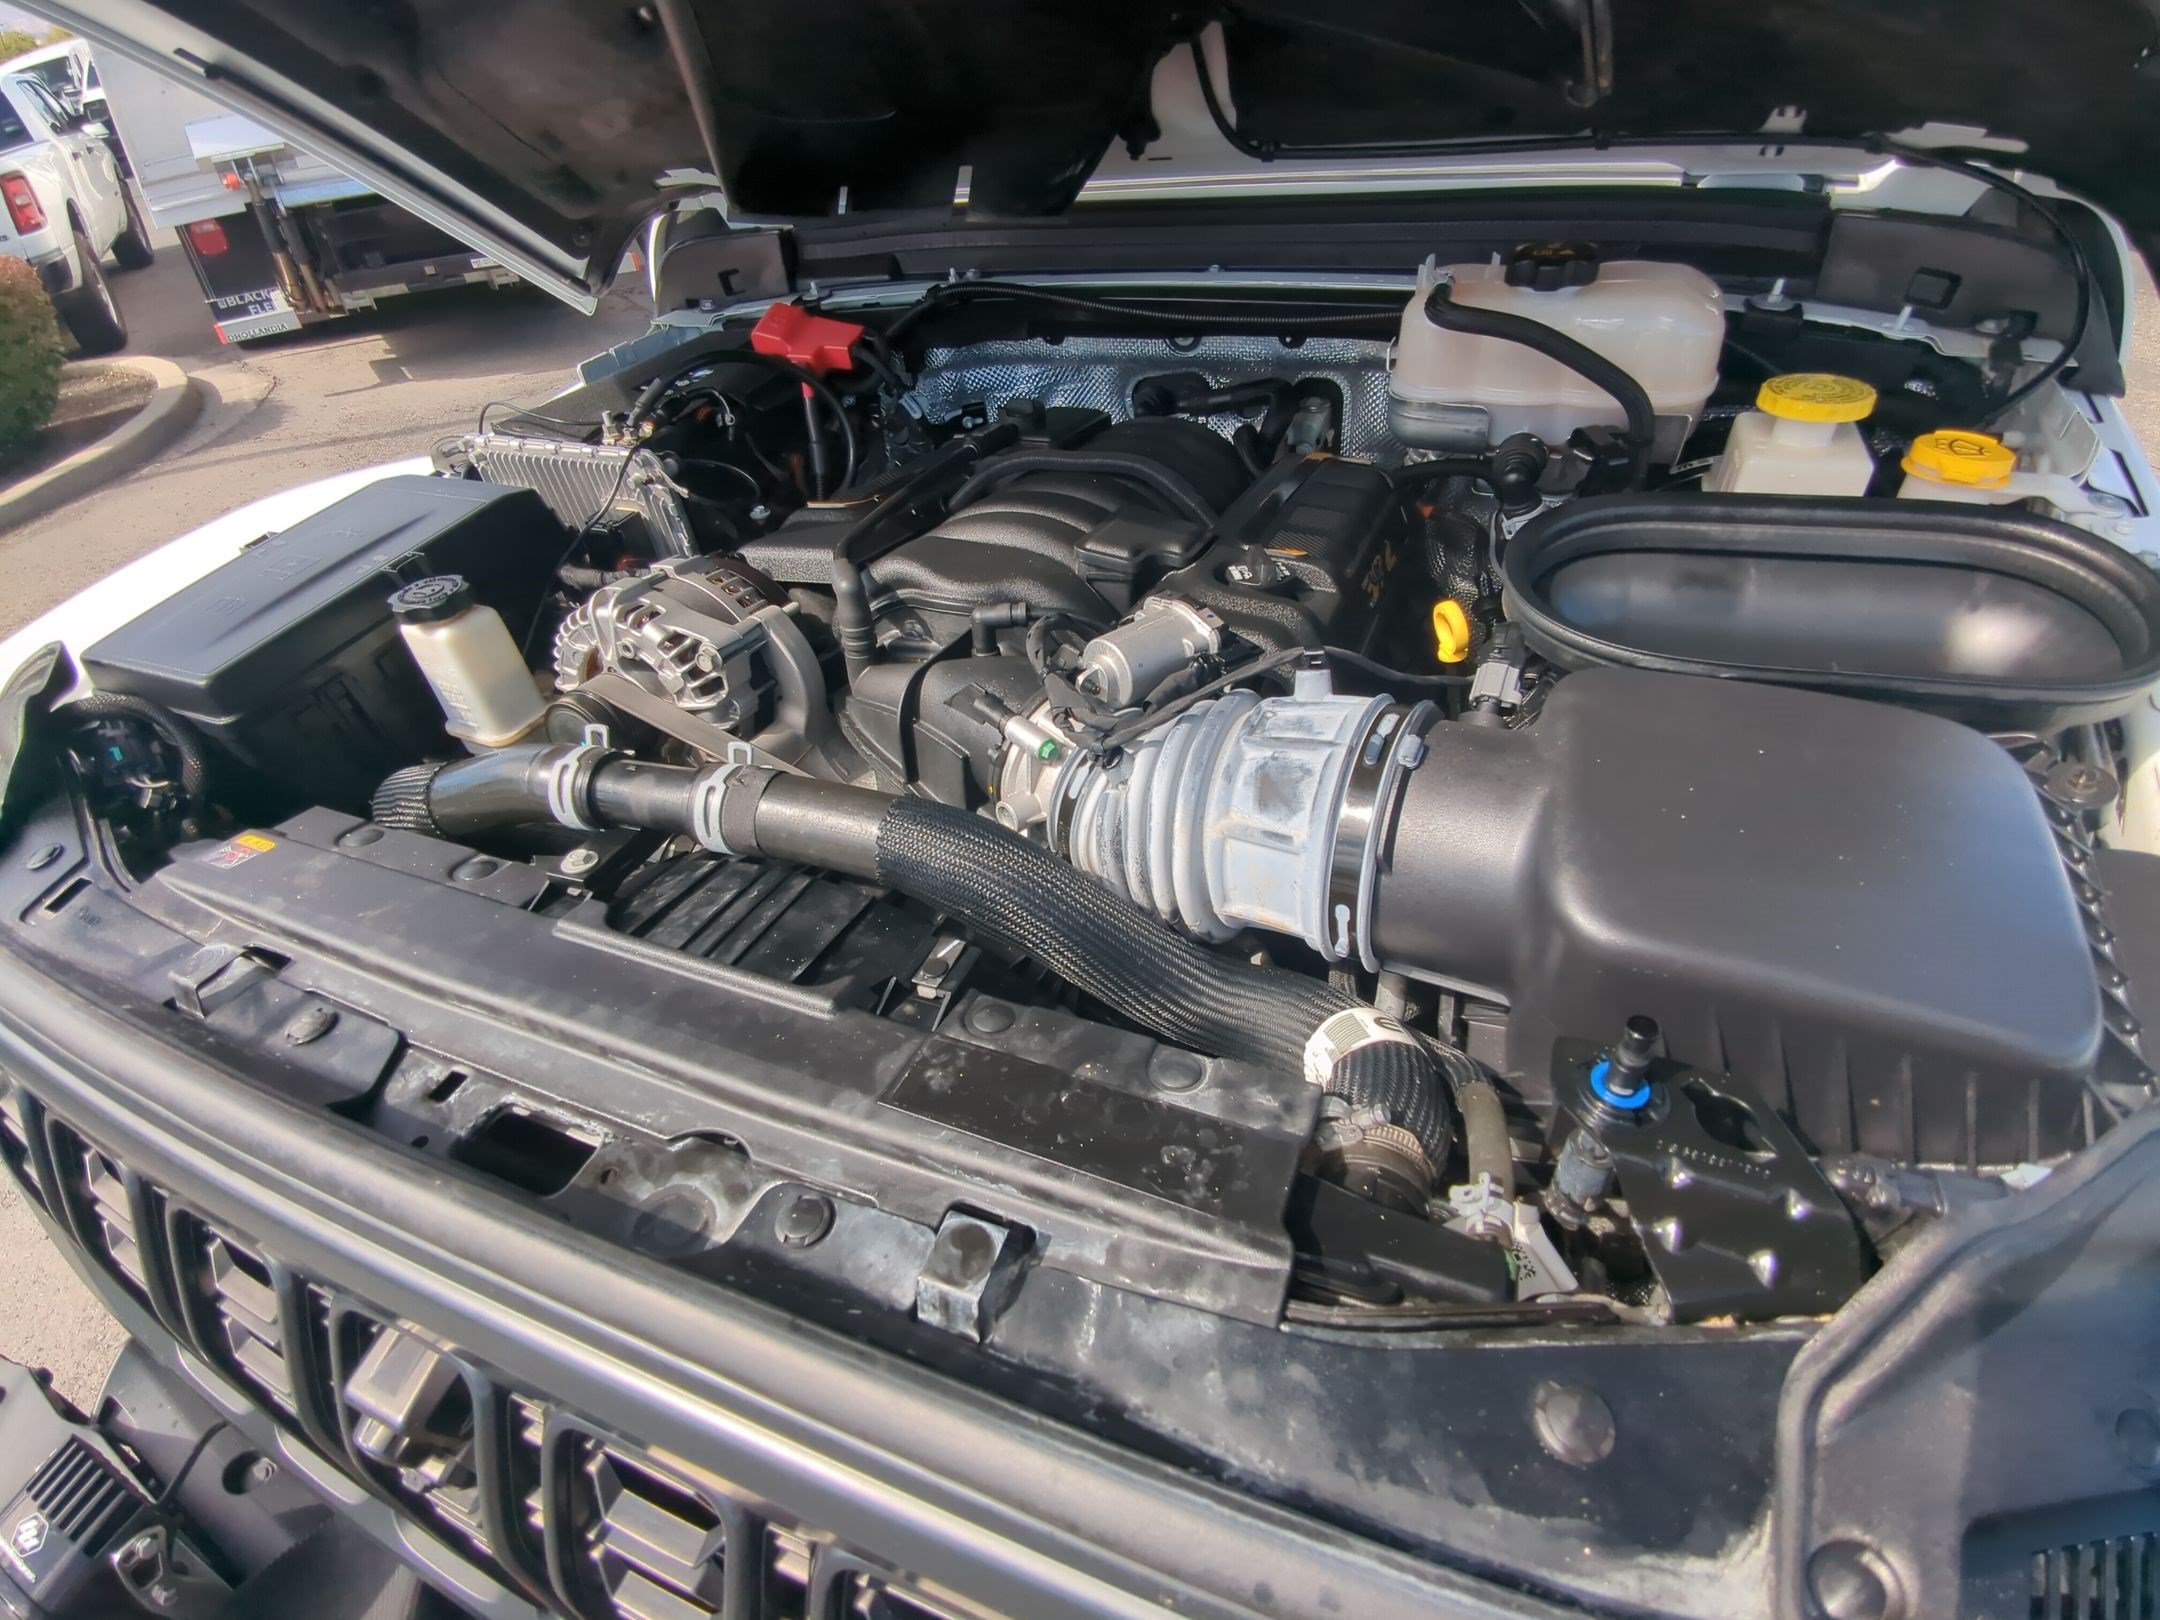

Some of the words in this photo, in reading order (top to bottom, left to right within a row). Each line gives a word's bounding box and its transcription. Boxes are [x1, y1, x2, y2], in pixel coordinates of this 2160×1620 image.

[226, 288, 274, 307] BLACK
[248, 302, 275, 316] FLE
[227, 323, 288, 342] DHOLLANDIA
